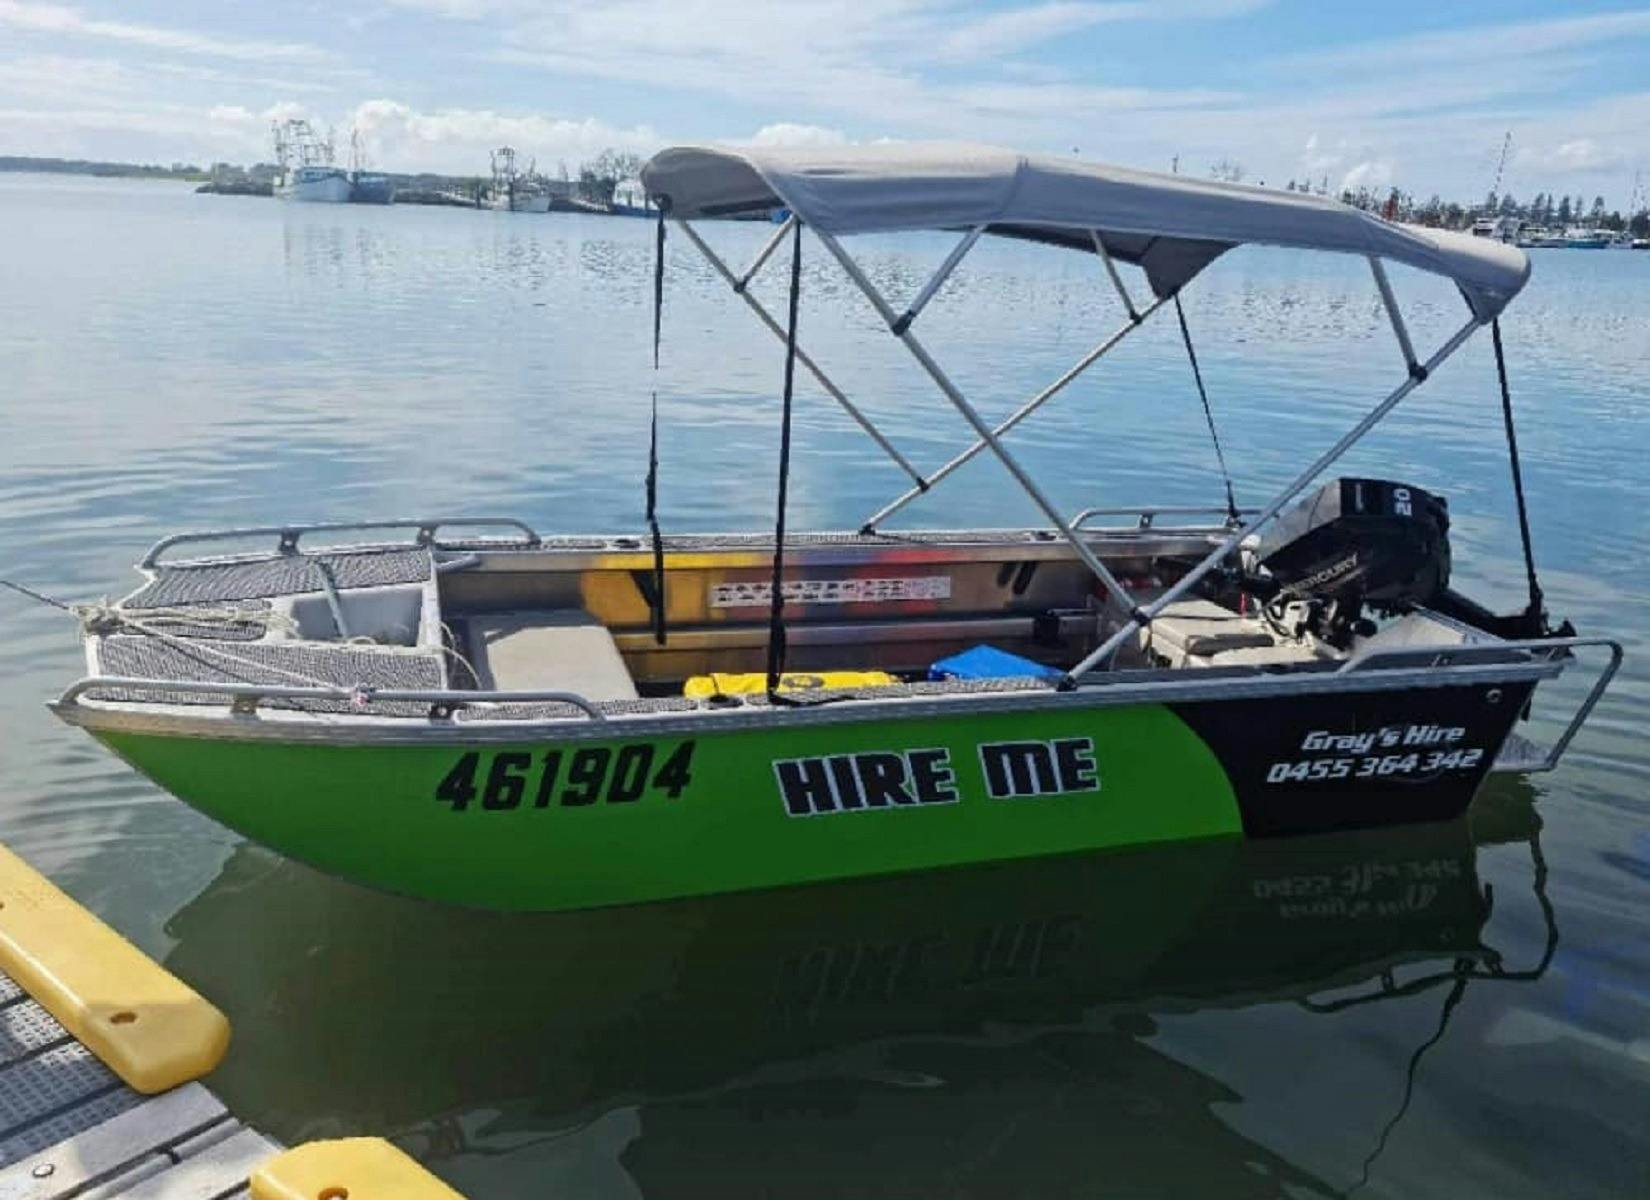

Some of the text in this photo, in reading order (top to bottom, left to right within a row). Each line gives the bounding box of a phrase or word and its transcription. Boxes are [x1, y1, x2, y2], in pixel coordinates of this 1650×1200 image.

[1393, 488, 1412, 516] 20
[1302, 724, 1466, 753] Gray's Hire
[434, 739, 697, 812] 461904
[772, 737, 1101, 818] HIRE ME
[1266, 748, 1484, 784] 0455 364 342
